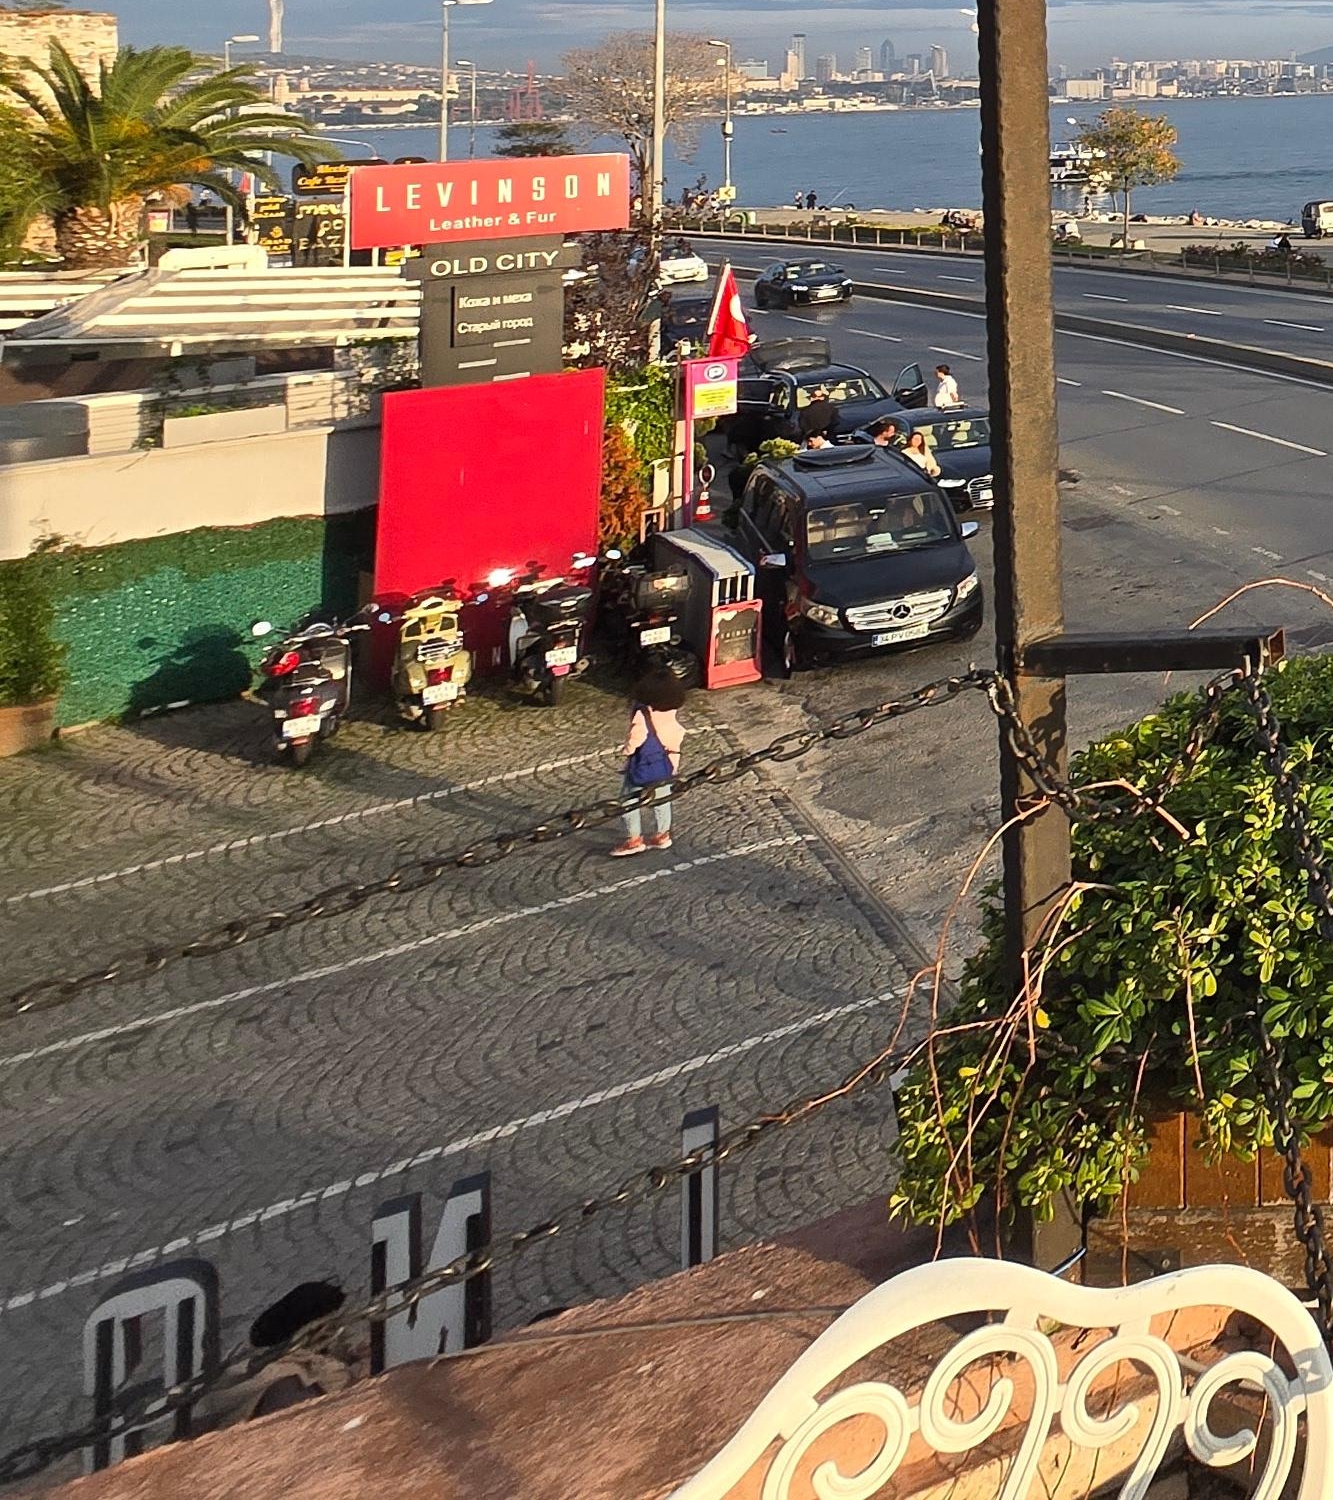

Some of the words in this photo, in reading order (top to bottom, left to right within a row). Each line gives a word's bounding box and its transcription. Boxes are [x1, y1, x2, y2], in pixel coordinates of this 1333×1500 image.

[376, 172, 610, 212] LEVINSON
[429, 214, 502, 232] Leather
[508, 213, 520, 226] &
[526, 211, 557, 225] Fur
[430, 256, 488, 277] OLD
[495, 250, 559, 271] CITY
